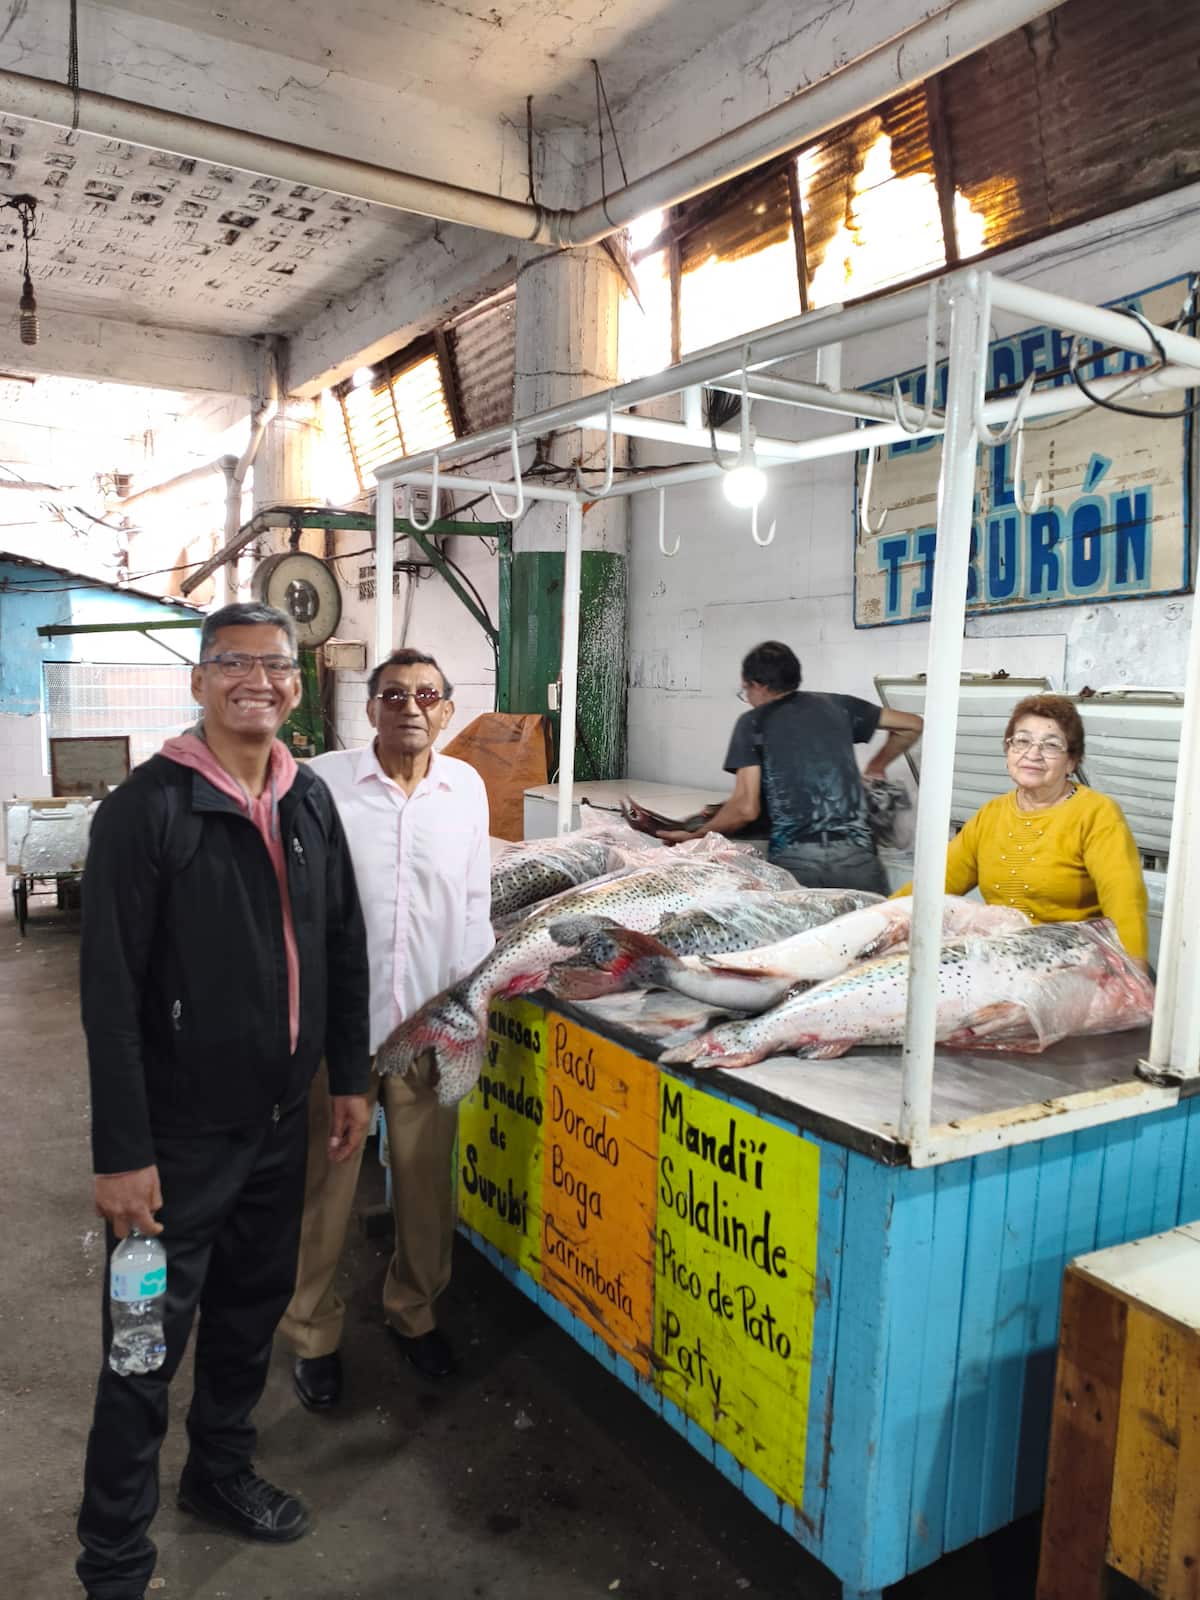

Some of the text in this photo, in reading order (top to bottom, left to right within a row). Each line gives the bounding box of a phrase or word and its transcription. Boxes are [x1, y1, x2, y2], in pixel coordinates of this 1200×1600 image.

[878, 453, 1152, 617] TIBURÓN
[487, 1039, 499, 1068] y
[554, 1022, 596, 1091] Pacú
[490, 1115, 507, 1151] de
[552, 1085, 620, 1167] Dorado
[552, 1144, 604, 1230] Boga
[660, 1156, 788, 1279] Solalinde
[543, 1213, 635, 1318] Carimbata
[660, 1229, 793, 1360] Pico de Pato
[662, 1309, 723, 1416] Paty
